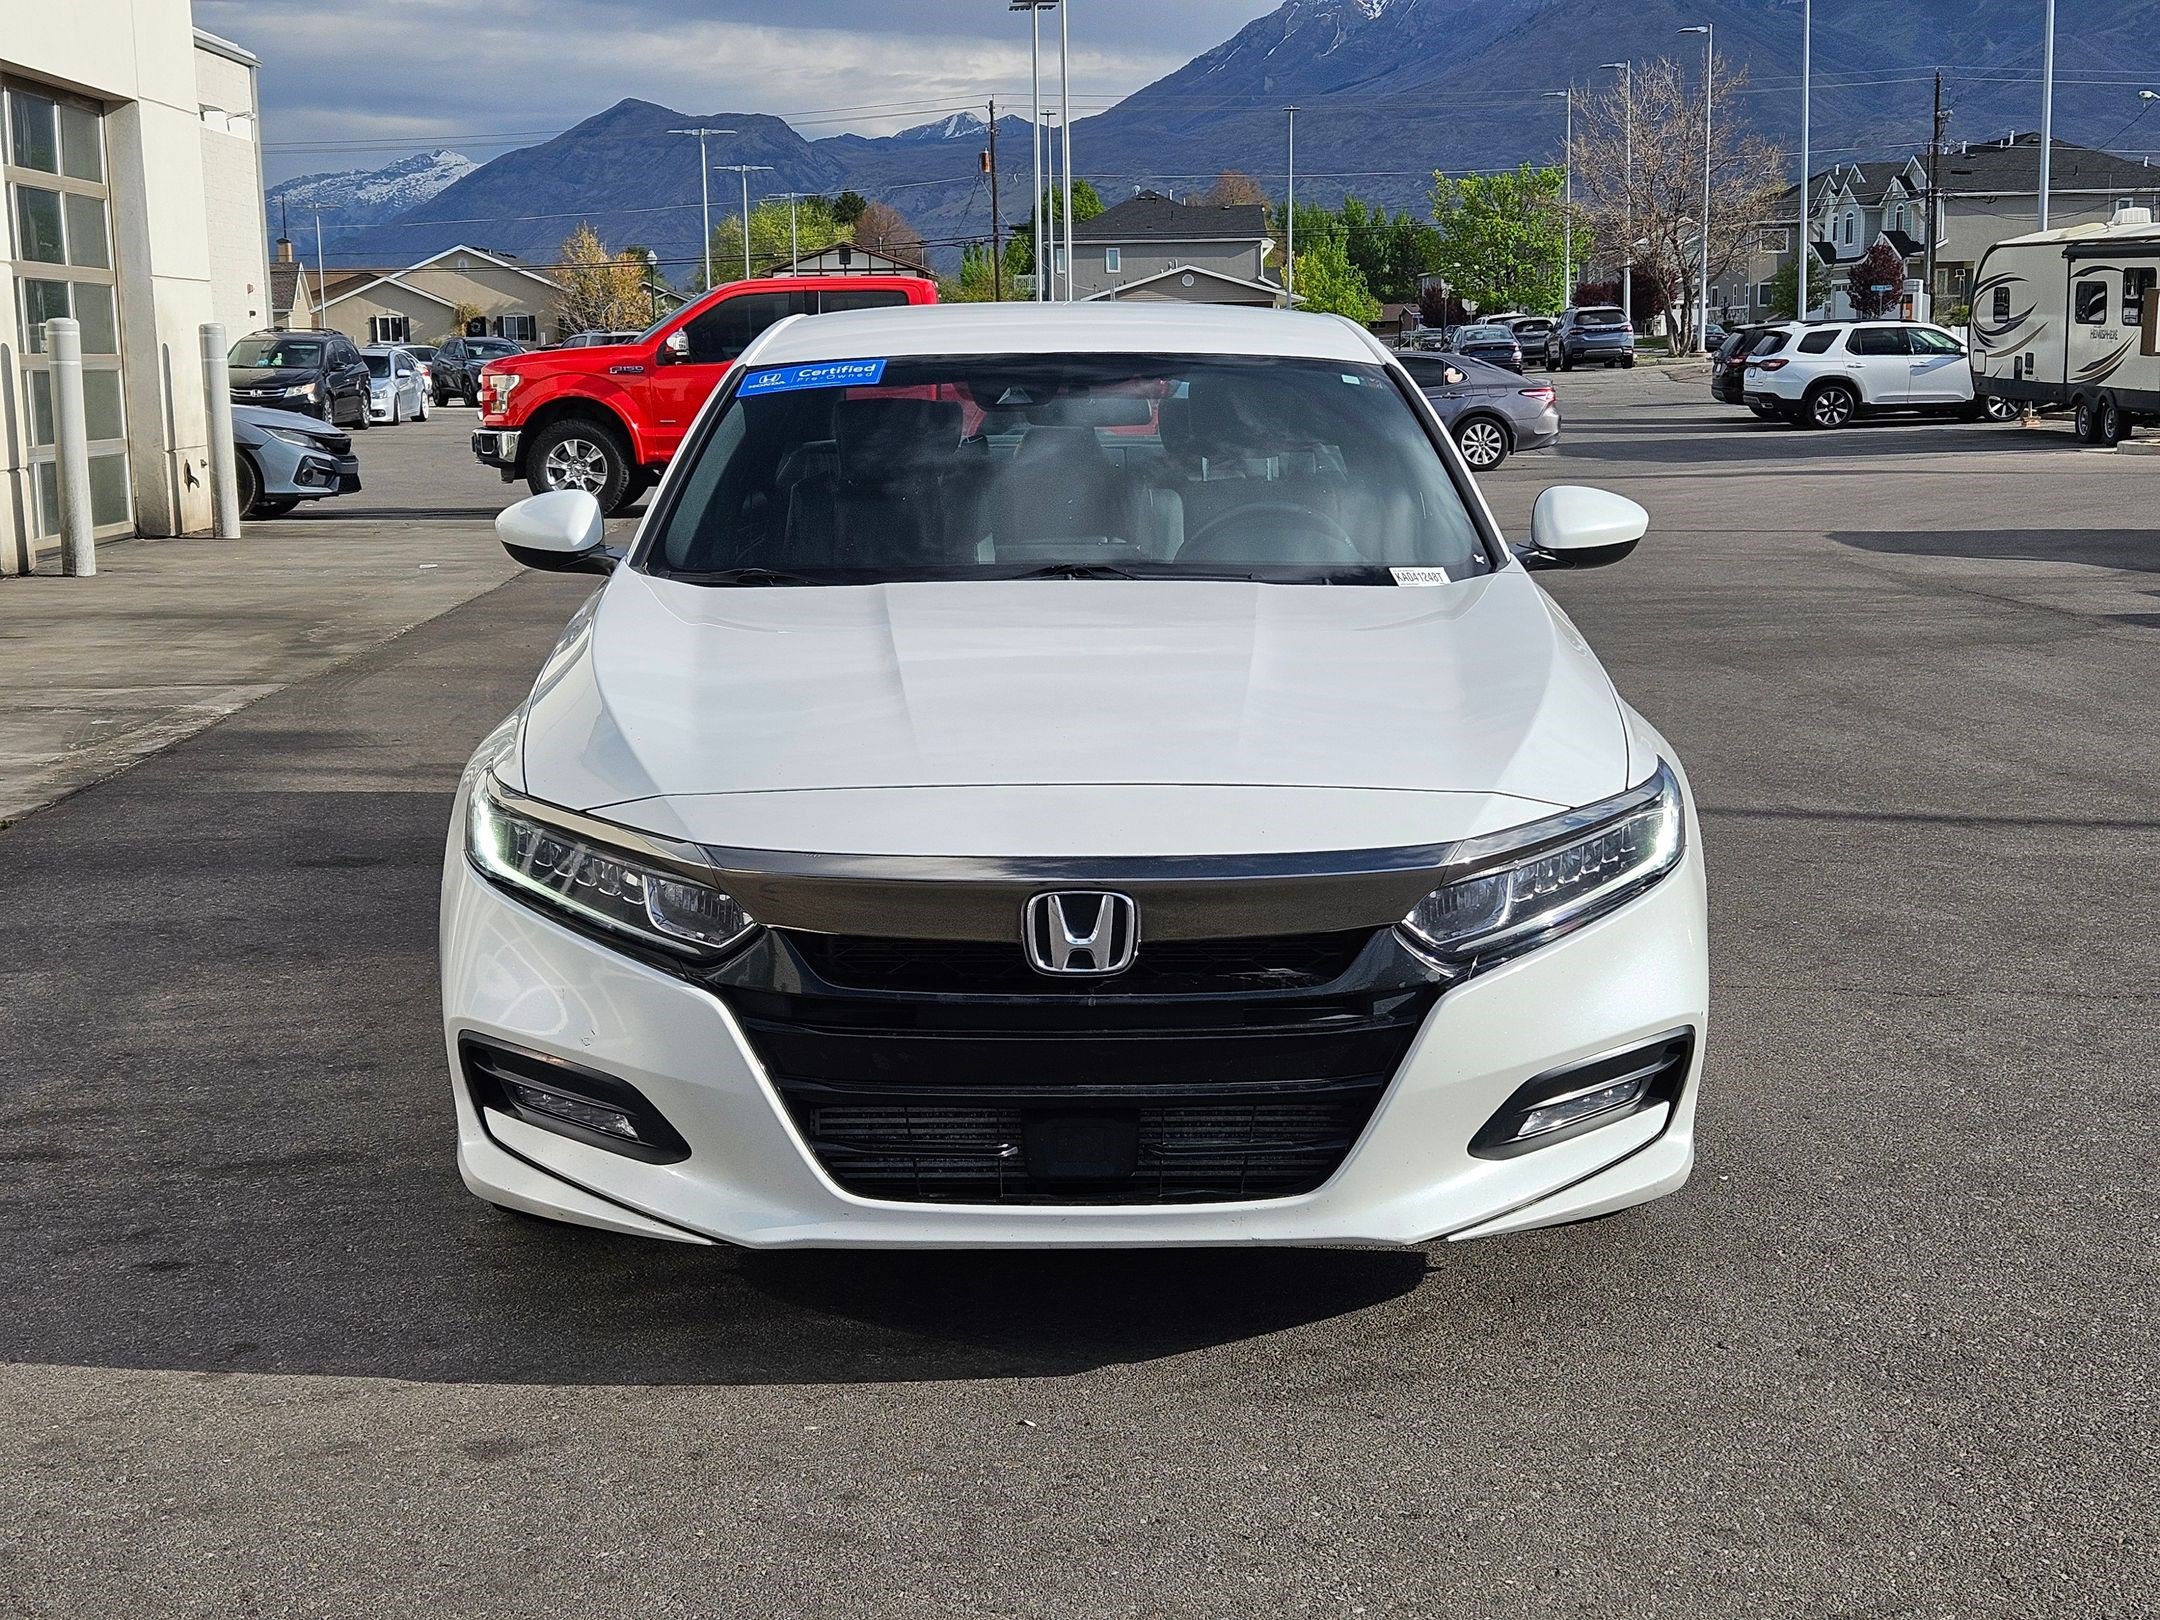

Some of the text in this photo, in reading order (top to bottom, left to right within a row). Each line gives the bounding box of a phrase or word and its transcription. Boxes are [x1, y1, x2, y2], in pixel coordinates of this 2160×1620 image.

[798, 363, 877, 377] Certified
[796, 372, 873, 383] Pre-Owned
[747, 380, 786, 389] HONDA
